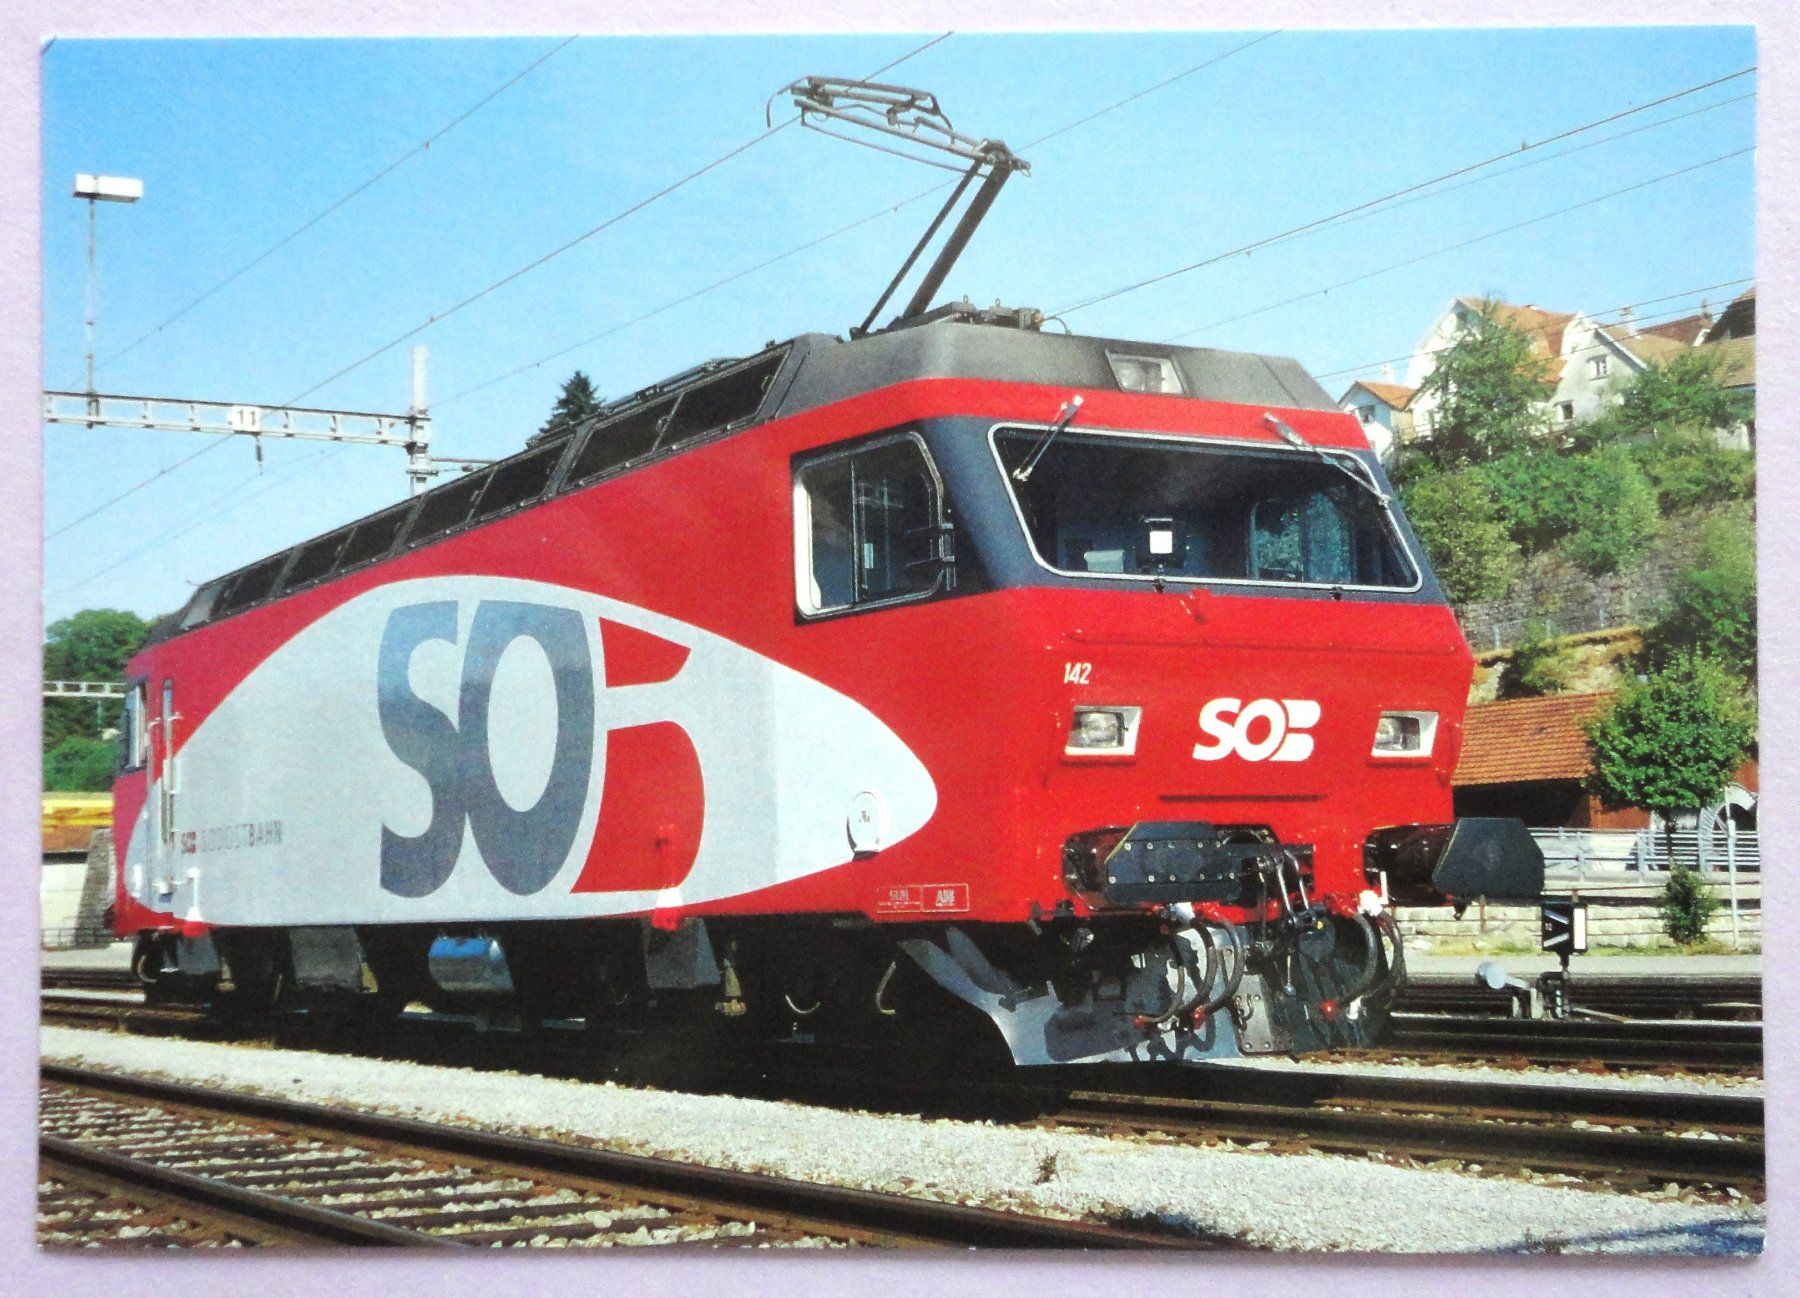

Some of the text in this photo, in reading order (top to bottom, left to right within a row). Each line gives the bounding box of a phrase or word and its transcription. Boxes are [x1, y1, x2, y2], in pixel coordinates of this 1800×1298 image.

[237, 409, 256, 426] 11
[1063, 662, 1092, 685] 142
[1192, 697, 1321, 762] SOB
